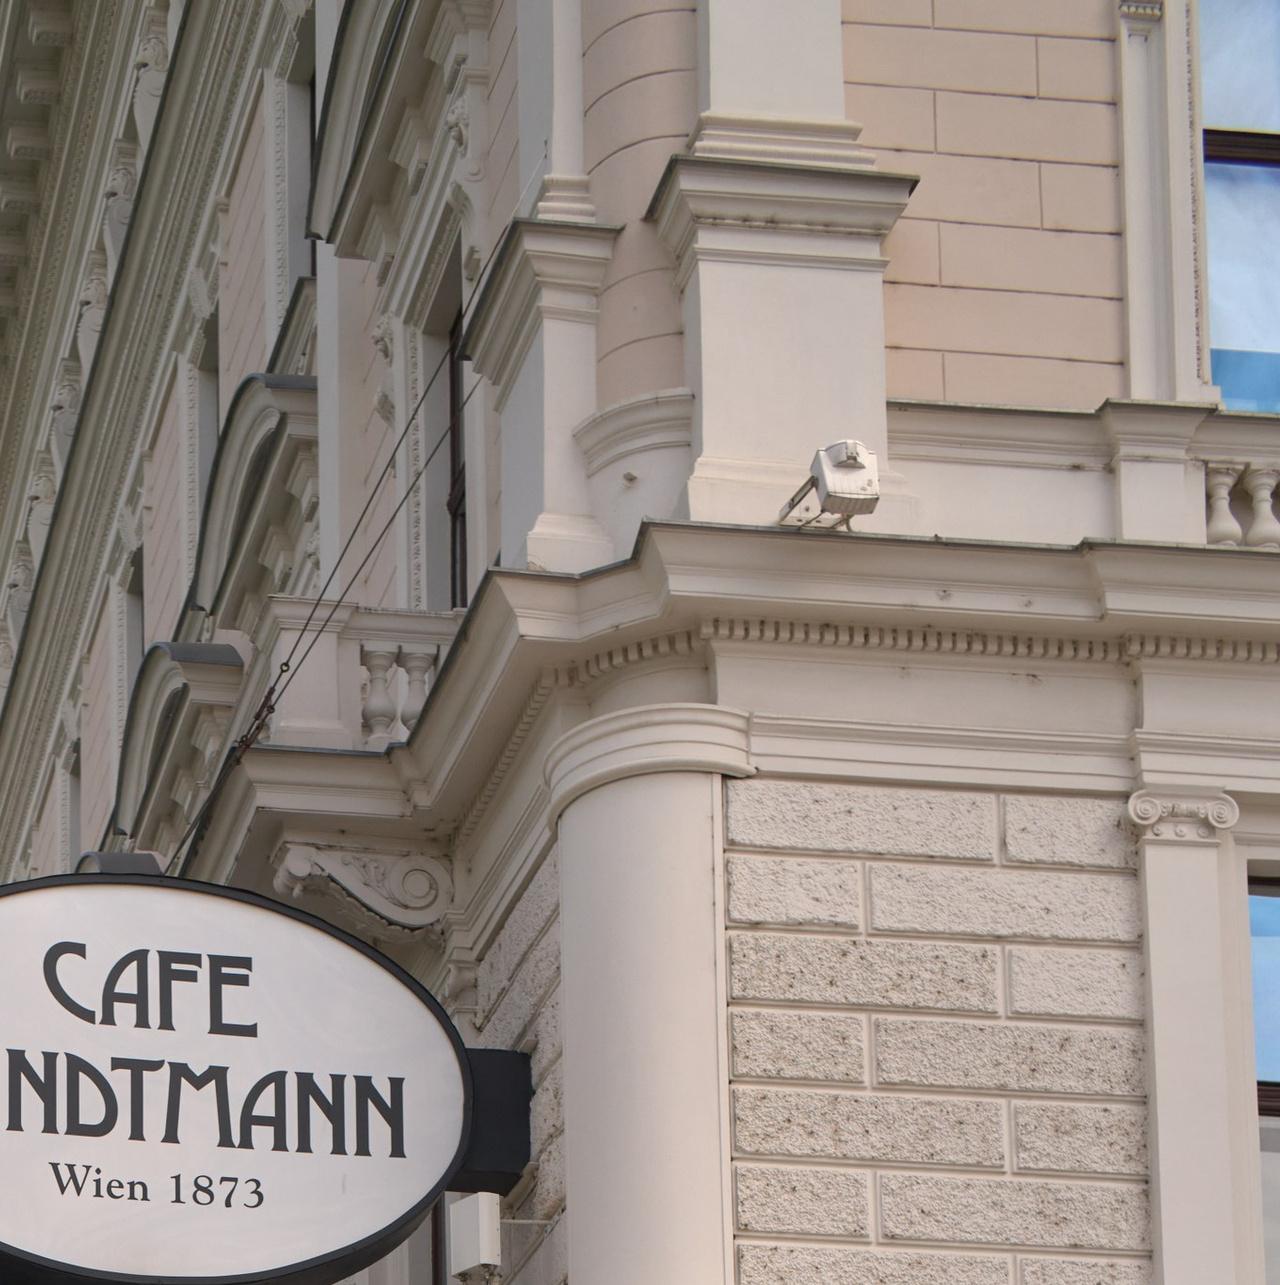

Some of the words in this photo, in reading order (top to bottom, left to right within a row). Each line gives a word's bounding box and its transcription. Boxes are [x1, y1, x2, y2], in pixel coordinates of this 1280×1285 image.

[42, 940, 259, 1039] CAFE
[48, 1161, 151, 1202] Wien
[169, 1174, 265, 1209] 1873
